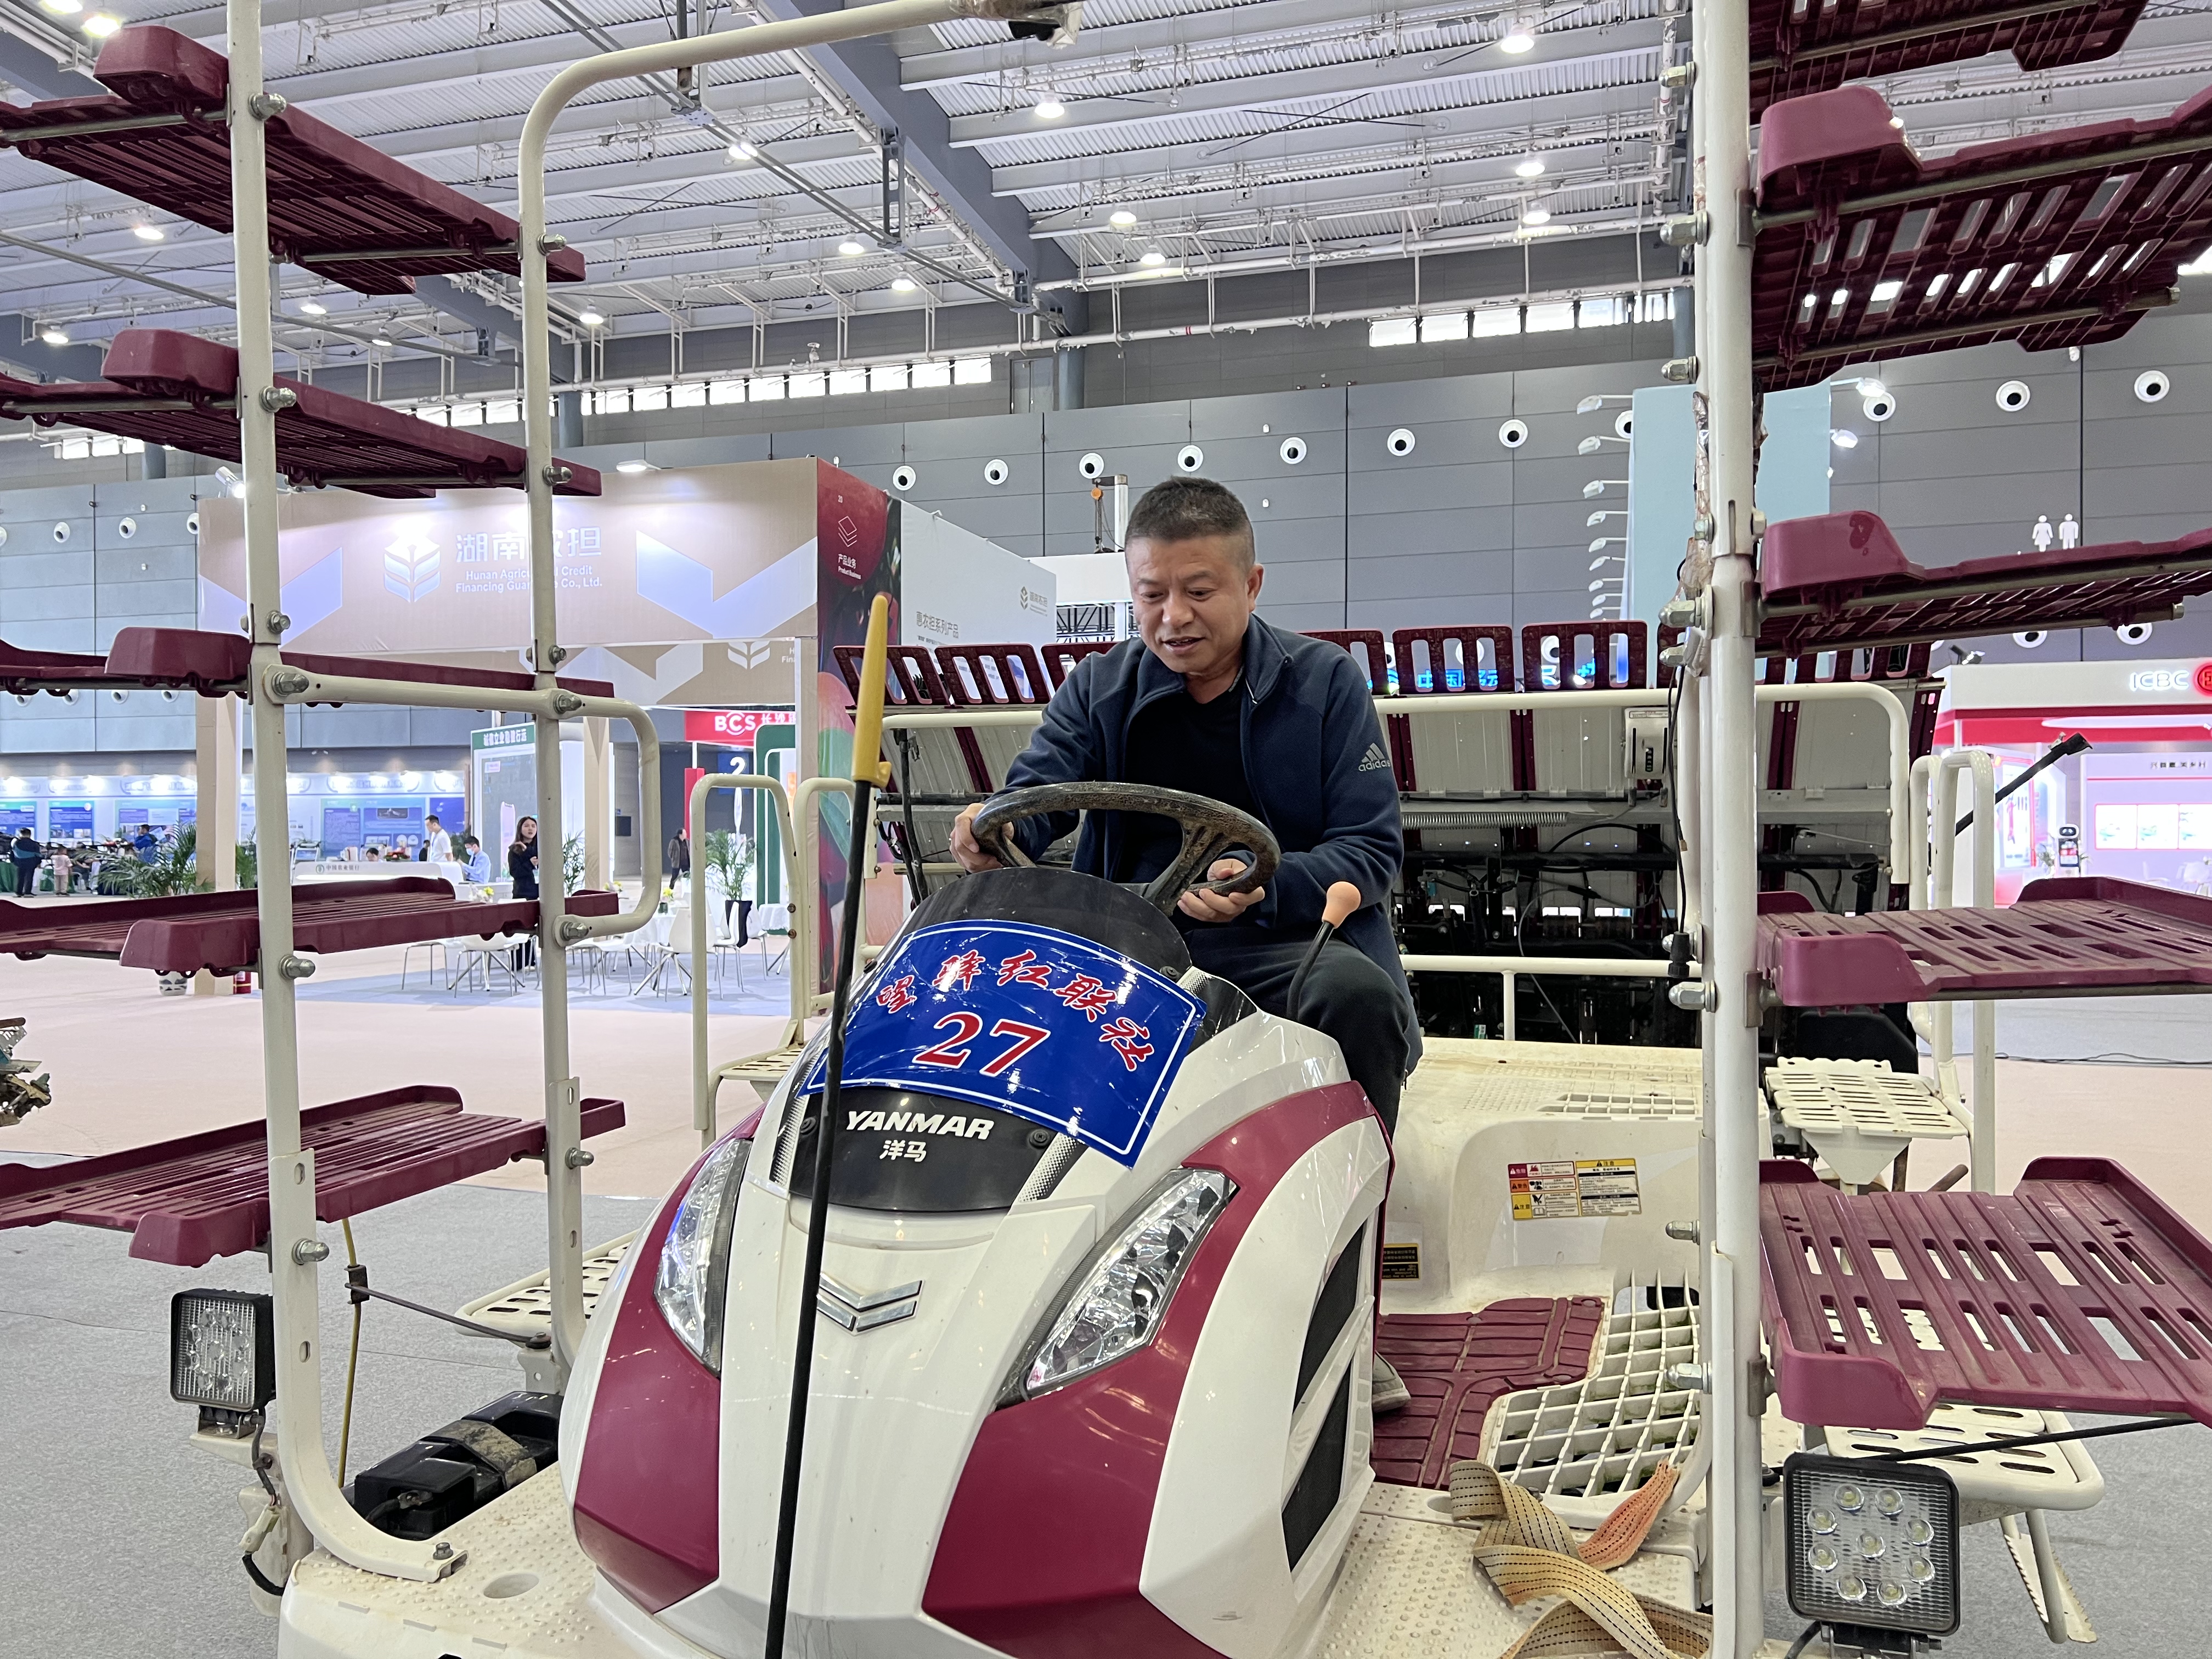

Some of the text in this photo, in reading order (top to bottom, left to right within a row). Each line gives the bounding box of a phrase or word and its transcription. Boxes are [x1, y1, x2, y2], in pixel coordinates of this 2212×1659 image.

[466, 571, 498, 580] Hunan
[561, 565, 592, 576] Credit
[455, 582, 504, 593] Financing
[561, 578, 581, 589] Co.,
[583, 577, 603, 587] Ltd.
[2131, 670, 2190, 690] ICBC
[714, 714, 756, 731] BCS
[1358, 758, 1391, 772] adidas
[912, 1011, 1052, 1077] 27
[845, 1110, 995, 1141] YANMAR
[879, 1139, 927, 1163] 洋马
